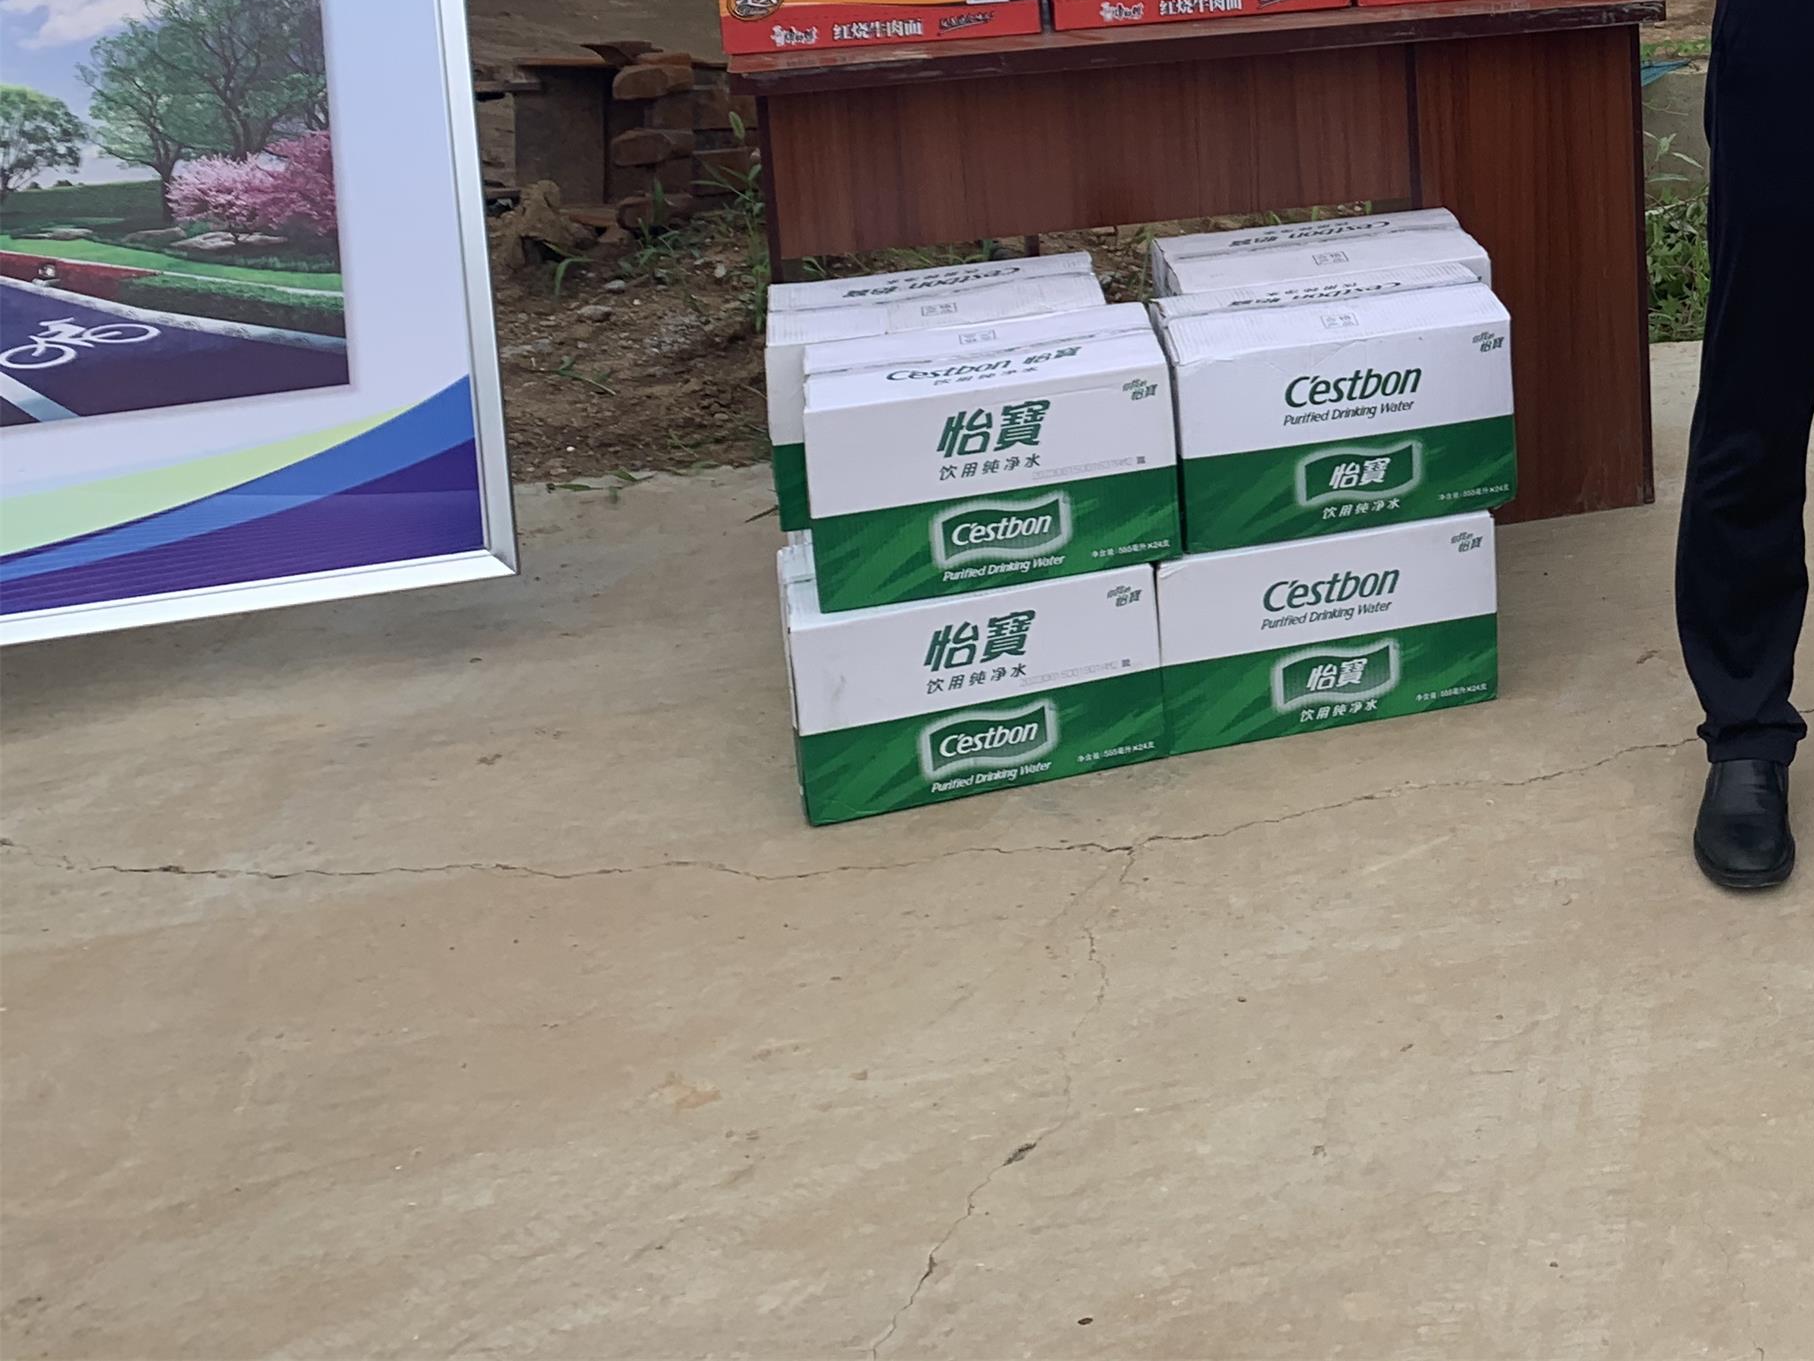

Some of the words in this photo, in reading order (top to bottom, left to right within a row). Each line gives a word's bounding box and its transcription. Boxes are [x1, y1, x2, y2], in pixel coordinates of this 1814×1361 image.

[833, 20, 923, 40] 红烧牛肉面
[1285, 367, 1422, 408] C'estbon
[1283, 408, 1328, 426] Purified
[1331, 404, 1376, 420] Drinking
[1380, 400, 1414, 413] Water
[936, 400, 1050, 458] 怡寶
[939, 453, 1041, 480] 饮用纯净水
[1329, 457, 1391, 489] 怡寶
[1322, 498, 1400, 519] 饮用纯净水
[952, 515, 1052, 546] C'estbon
[943, 565, 986, 581] Purified
[987, 559, 1031, 574] Drinking
[1033, 555, 1065, 568] Water
[1263, 569, 1400, 612] C'estbon
[1261, 613, 1307, 630] Purified
[1309, 608, 1354, 623] Drinking
[1358, 601, 1392, 615] Water
[923, 610, 1036, 672] 怡寶
[926, 663, 1027, 694] 饮用纯净水
[1306, 658, 1368, 691] 怡寶
[1300, 699, 1378, 722] 饮用纯净水
[939, 722, 1038, 757] C'estbon
[931, 775, 973, 792] Purified
[975, 768, 1018, 785] Drinking
[1019, 761, 1051, 776] Water
